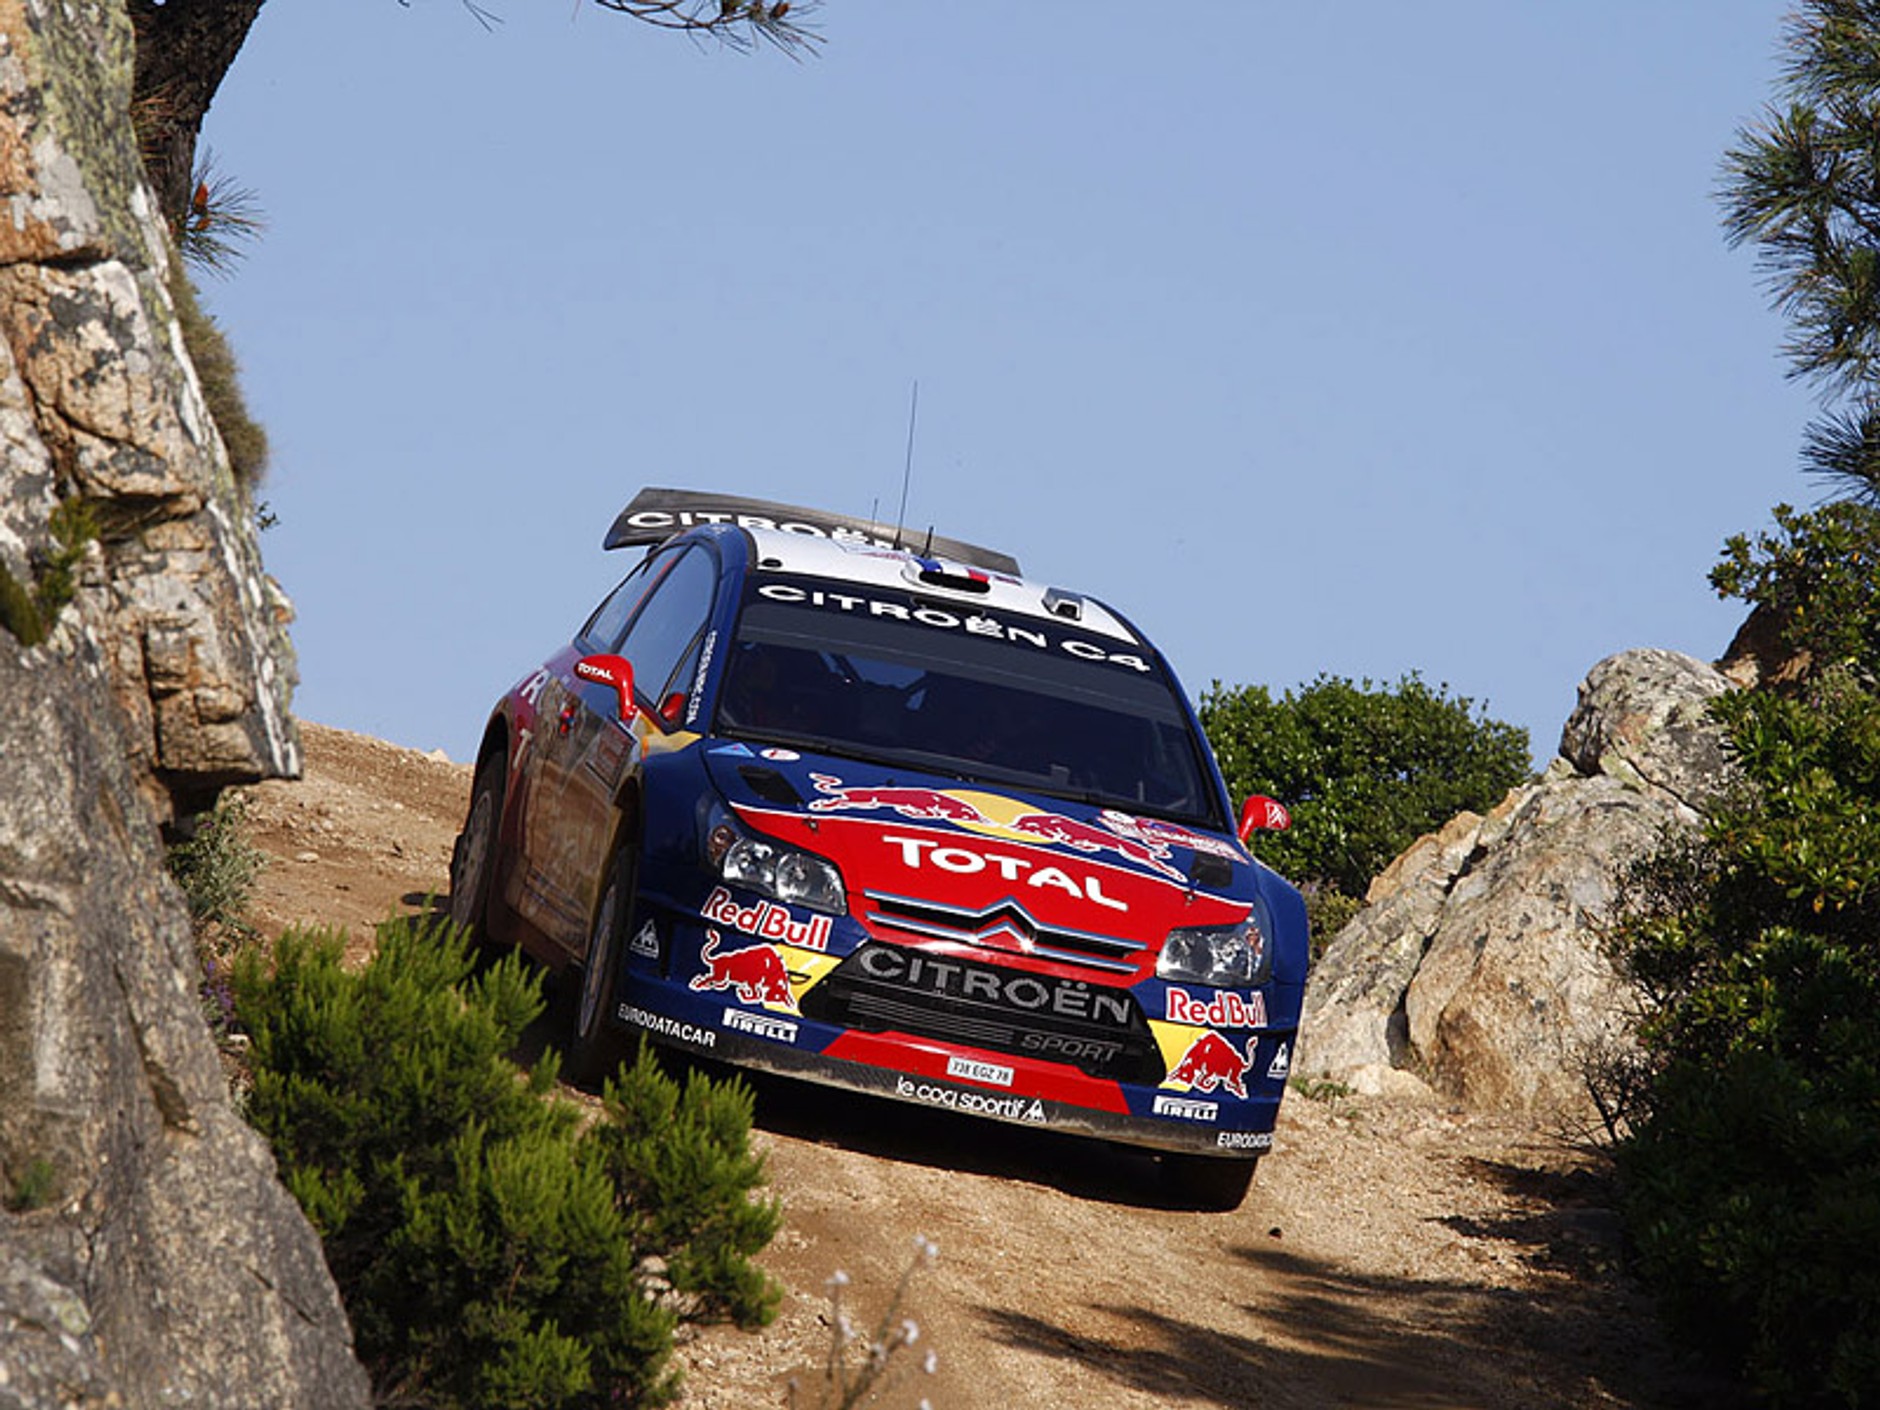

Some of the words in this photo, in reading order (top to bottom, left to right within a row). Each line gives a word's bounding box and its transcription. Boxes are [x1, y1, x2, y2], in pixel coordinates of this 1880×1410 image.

[759, 584, 1048, 648] CITROËN
[1061, 640, 1151, 672] C4
[577, 662, 614, 681] TOTAL
[882, 835, 1128, 912] TOTAL
[701, 887, 769, 934] Red
[759, 904, 833, 952] Bull
[859, 947, 1131, 1024] CITROËN
[617, 1003, 716, 1048] EURODATACAR
[722, 1007, 799, 1043] PIRELLI
[1165, 987, 1227, 1026] Red
[1225, 990, 1268, 1028] Bull
[1020, 1034, 1125, 1062] SPORT
[896, 1075, 914, 1096] le
[916, 1085, 957, 1109] coq
[959, 1093, 1025, 1118] sportif
[1152, 1095, 1219, 1121] PIRELLI
